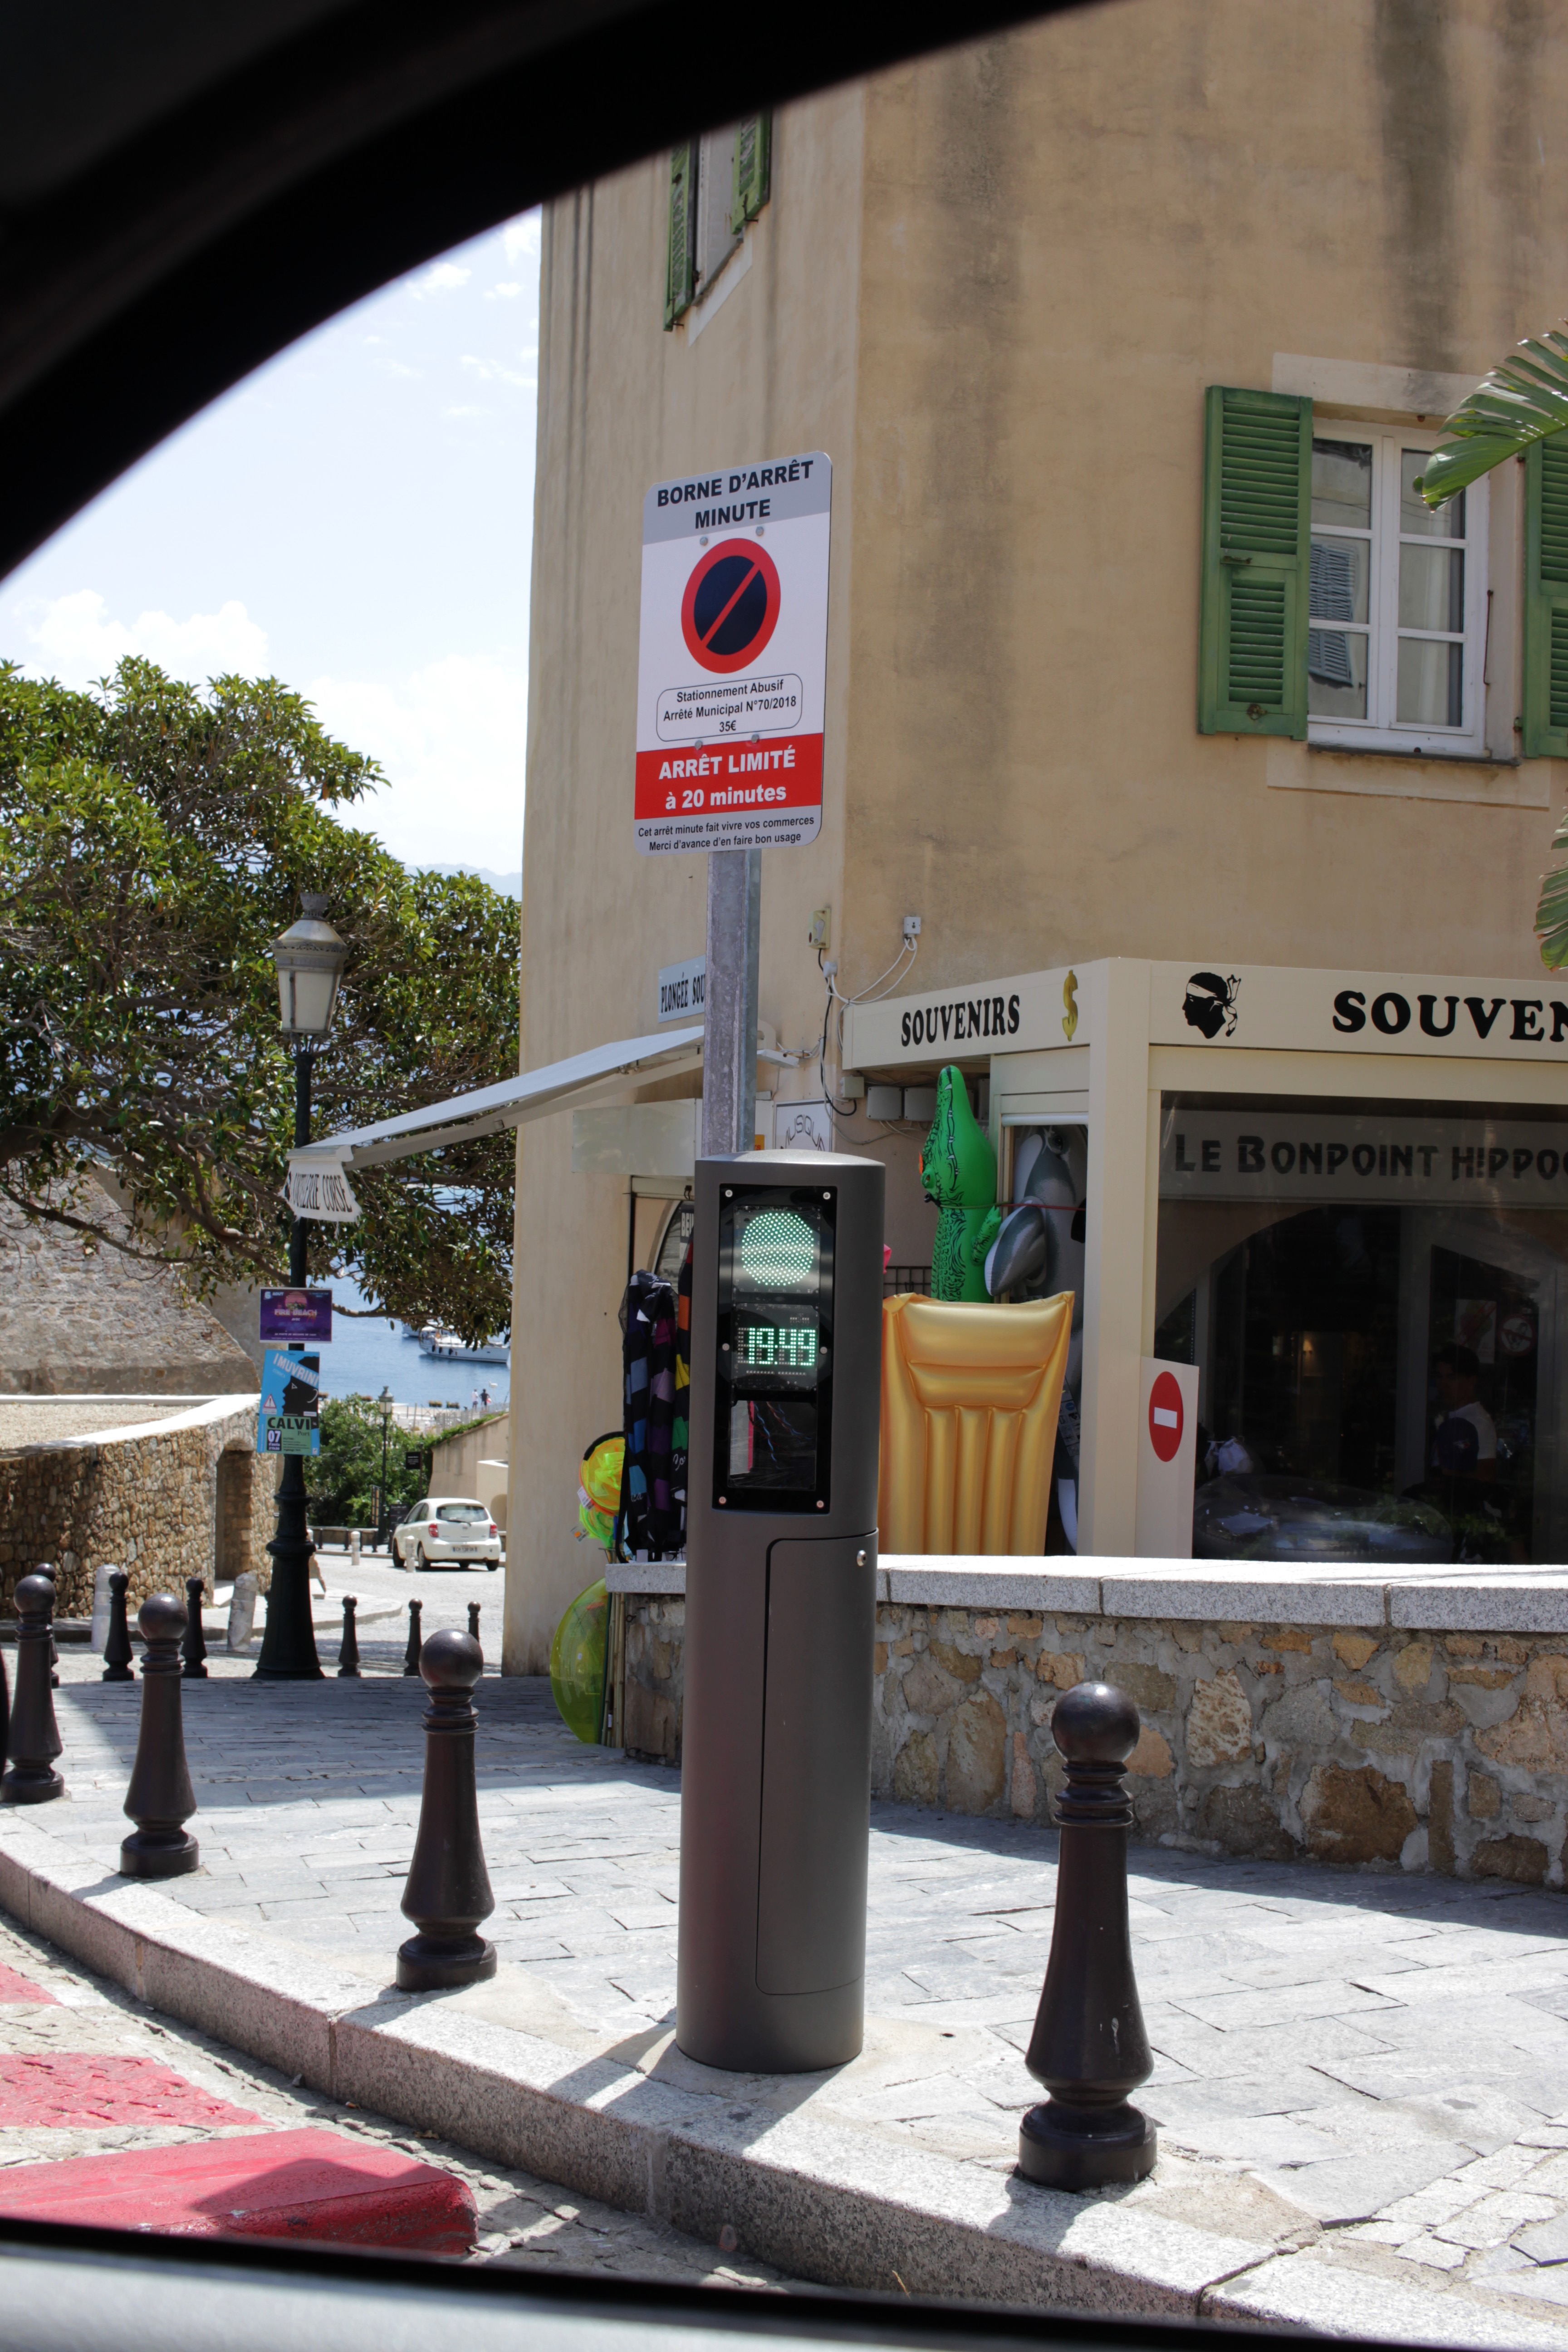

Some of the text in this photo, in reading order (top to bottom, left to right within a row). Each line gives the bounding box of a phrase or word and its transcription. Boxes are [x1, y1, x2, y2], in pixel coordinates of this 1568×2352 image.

[657, 459, 813, 507] BORNE D'ARRÊT
[695, 498, 770, 529] MINUTE
[676, 679, 784, 703] Stationnement Abusif
[663, 696, 796, 721] Arrêté Municipal N°70/2018
[719, 720, 736, 733] 35€
[659, 745, 795, 780] ARRÊT LIMITÉ
[665, 784, 787, 809] à 20 minutes
[638, 816, 814, 837] Cet arrêt minute fait vivre vos commerces
[649, 833, 801, 851] Merci d'avance d'en faire bon usage
[661, 971, 688, 1013] PLONGÉE
[901, 994, 1020, 1047] SOUVENIRS
[1237, 1135, 1439, 1177] BONPOINT
[323, 1174, 352, 1213] CORSE
[273, 1352, 279, 1365] I
[277, 1355, 319, 1387] MUVRINI
[268, 1417, 310, 1430] CALVI
[268, 1430, 281, 1442] 07
